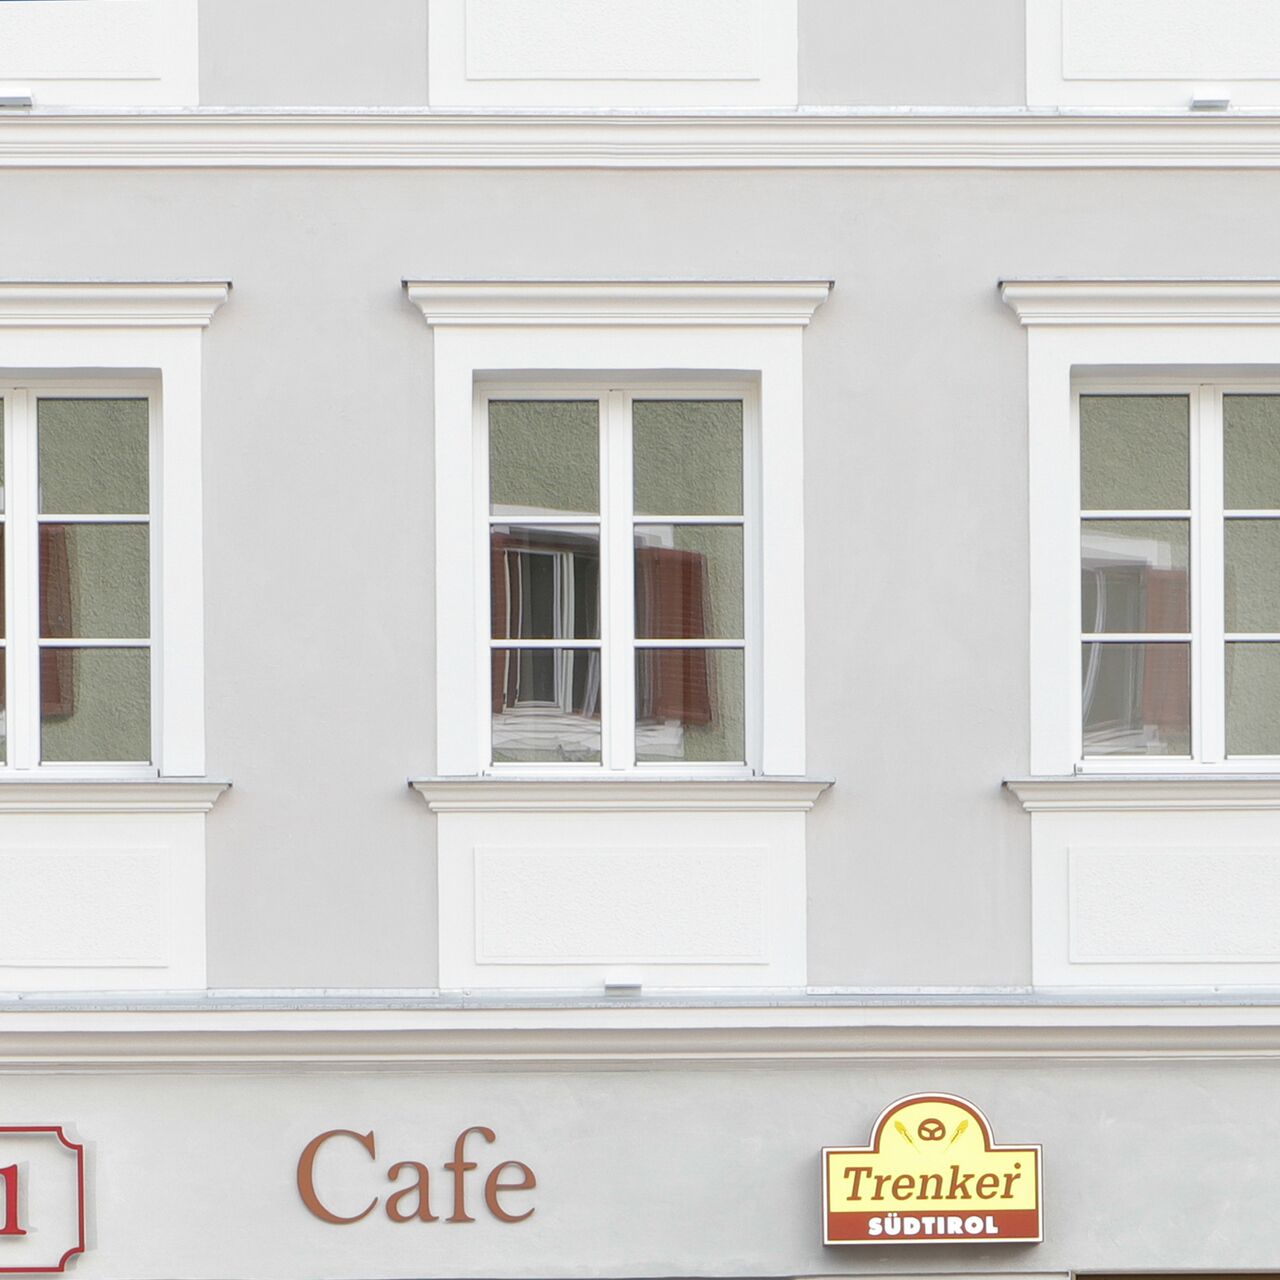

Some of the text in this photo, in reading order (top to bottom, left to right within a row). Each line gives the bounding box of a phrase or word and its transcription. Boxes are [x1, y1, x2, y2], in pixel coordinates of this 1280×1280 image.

[297, 1126, 537, 1225] Cafe
[843, 1164, 1022, 1201] Trenker
[868, 1211, 999, 1236] SÜDTIROL
